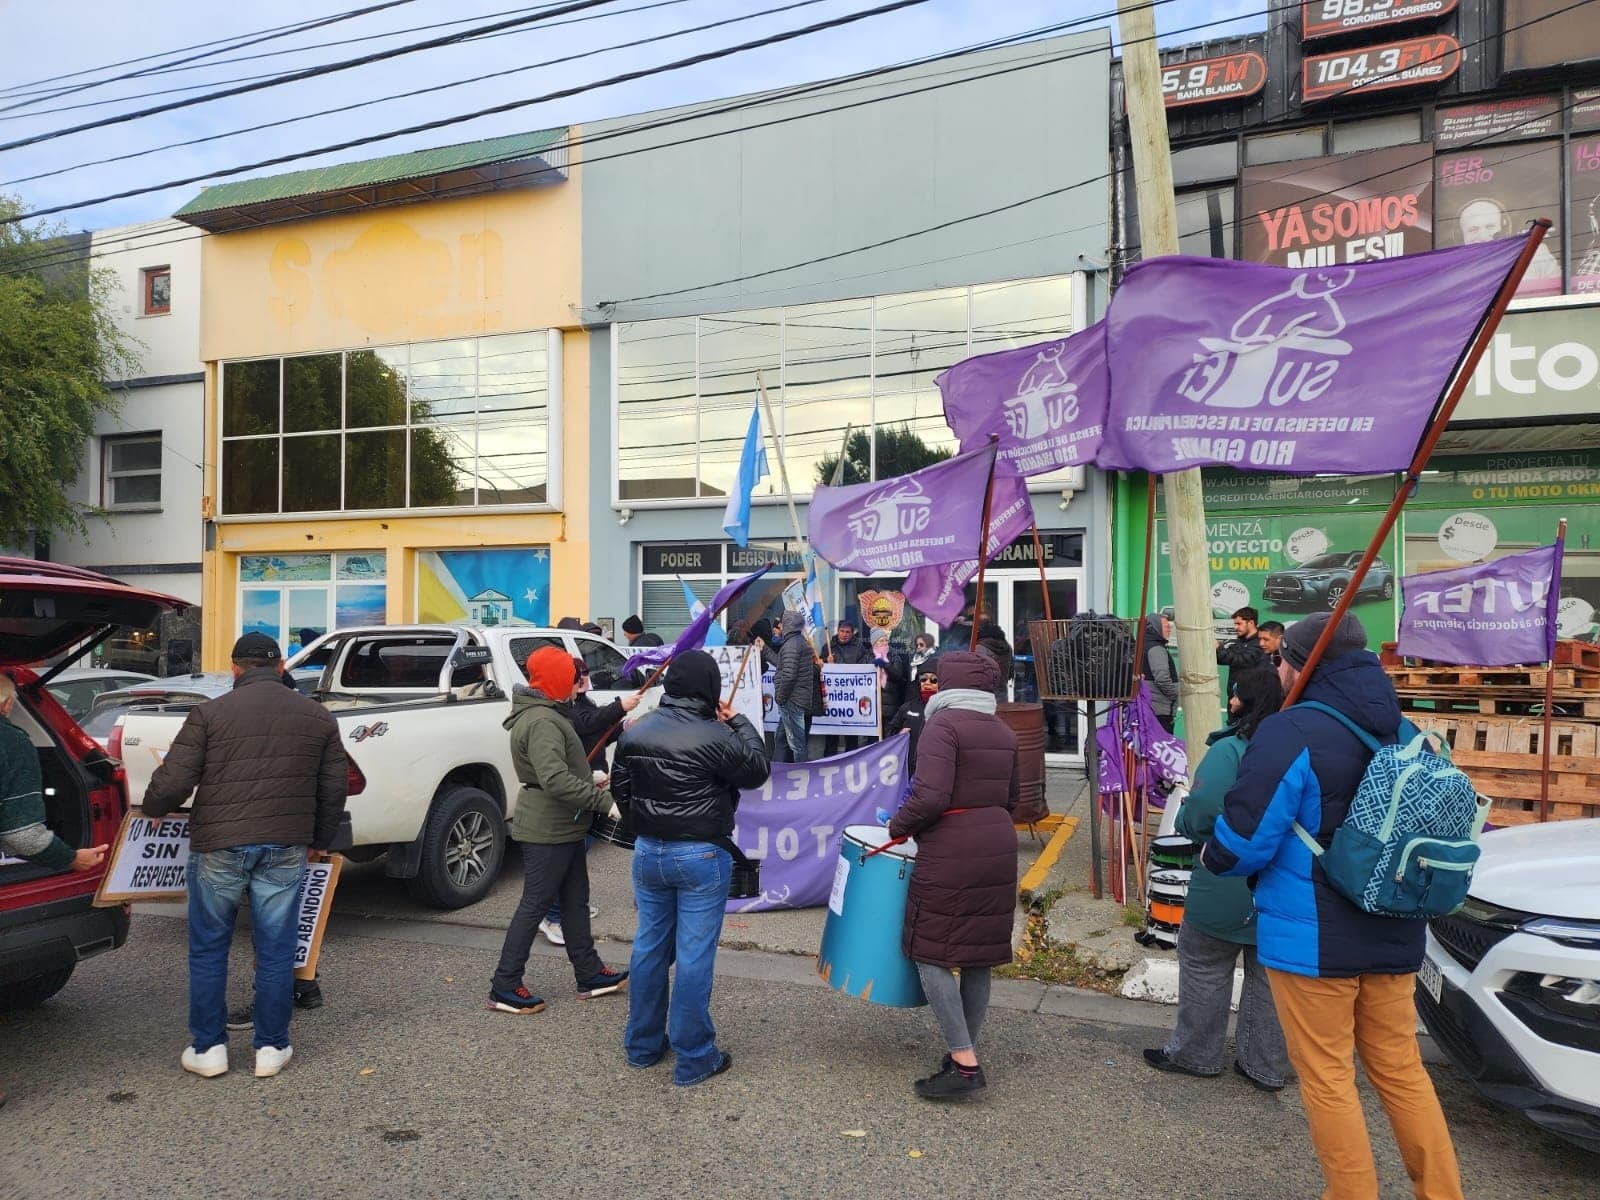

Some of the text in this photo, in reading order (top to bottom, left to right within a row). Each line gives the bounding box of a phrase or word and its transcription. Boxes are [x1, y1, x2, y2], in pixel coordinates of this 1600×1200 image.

[1342, 1, 1442, 26] CORONEL DORREGO
[1352, 64, 1443, 88] CORONEL SUÁREZ
[1176, 82, 1243, 100] BAHÍA BLANCA
[1441, 156, 1485, 175] FER
[1258, 193, 1419, 250] YA SOMOS
[1487, 454, 1591, 470] PROYECTA TU
[1464, 471, 1543, 485] VIVIENDA
[1472, 488, 1485, 499] O
[1489, 487, 1509, 499] TU
[1514, 484, 1562, 498] MOTO
[1454, 517, 1490, 531] Desde
[1442, 526, 1455, 540] $
[660, 552, 702, 567] PODER
[1222, 582, 1246, 595] Desde
[834, 674, 873, 687] servicio
[127, 819, 142, 842] 10
[141, 843, 180, 859] SIN
[295, 869, 328, 963] ES ABANDONO
